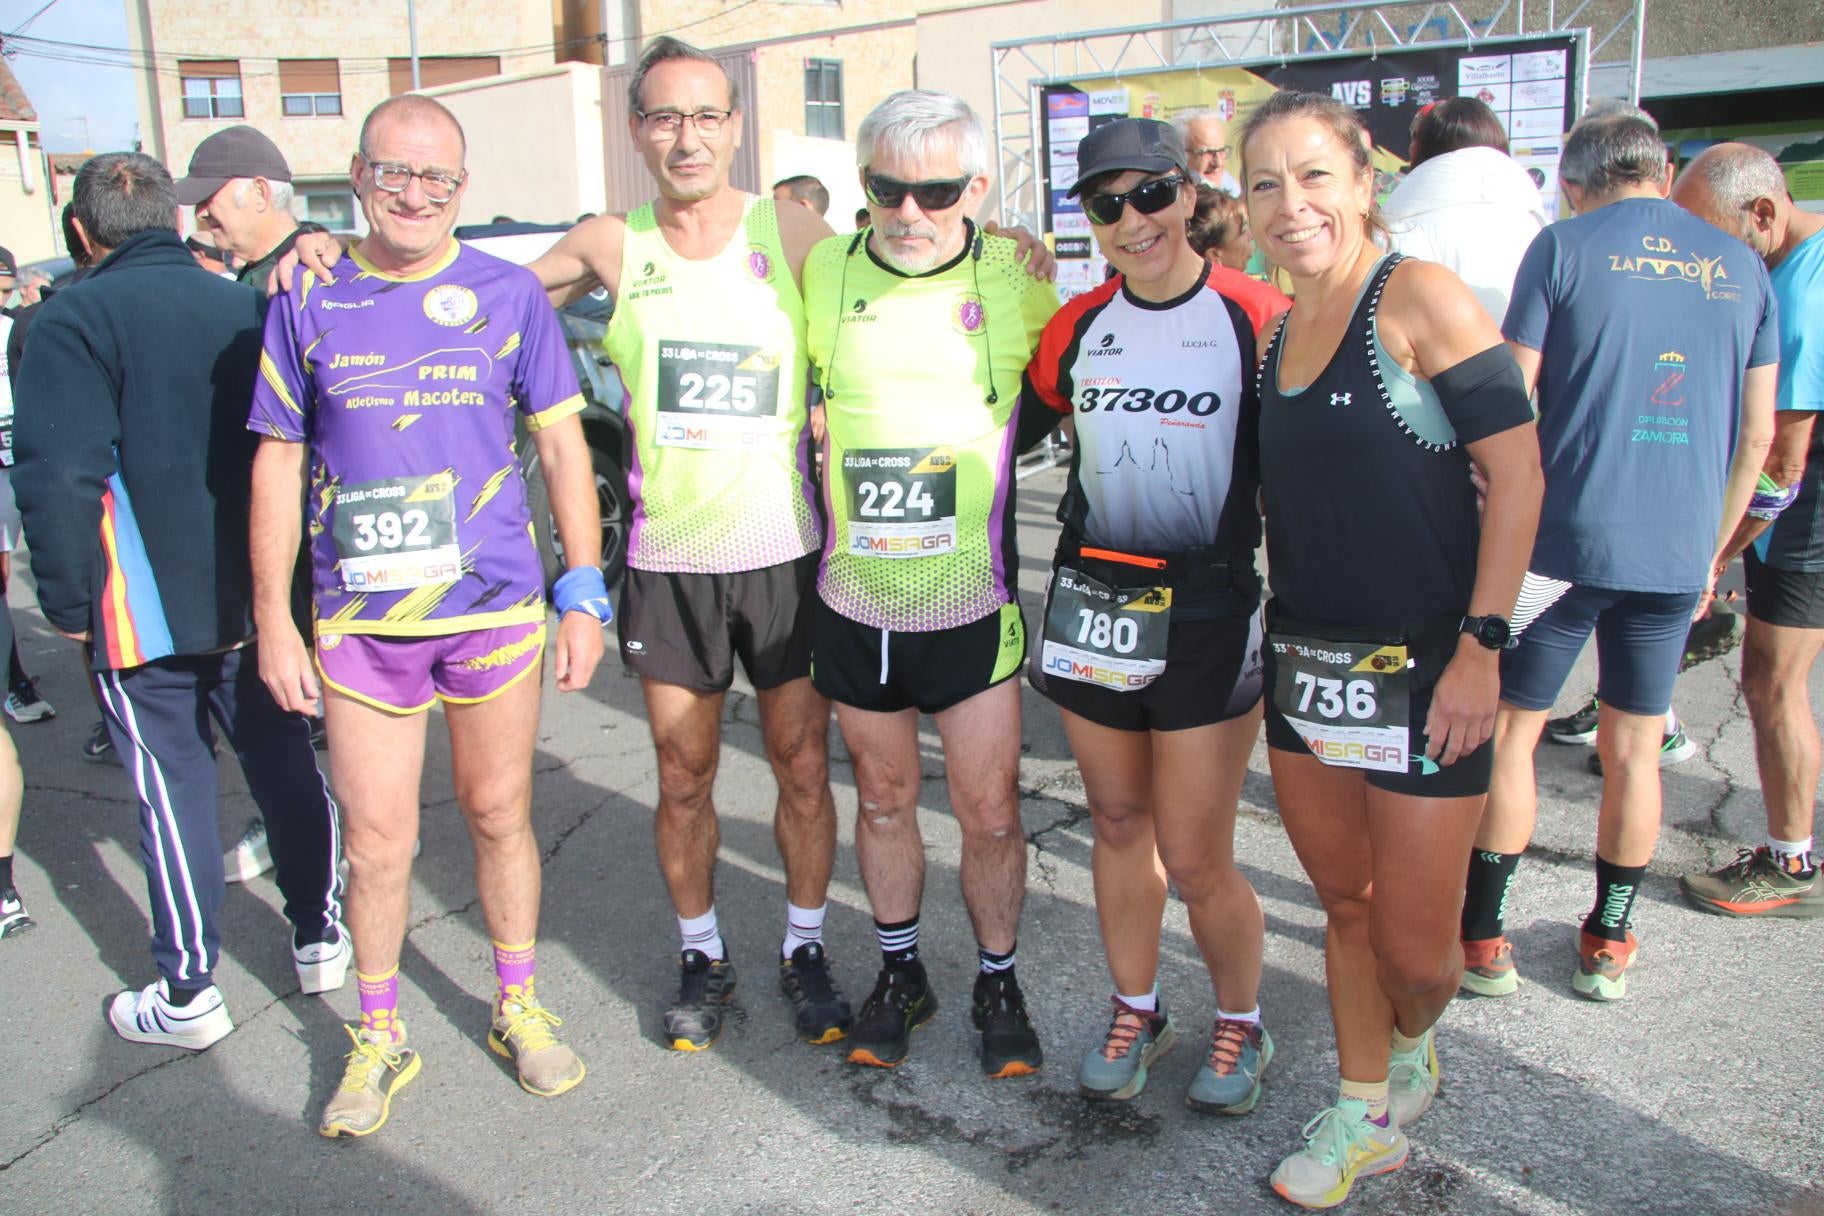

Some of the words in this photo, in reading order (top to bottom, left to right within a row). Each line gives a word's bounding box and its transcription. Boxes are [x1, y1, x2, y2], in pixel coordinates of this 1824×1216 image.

[1332, 80, 1372, 105] AVS
[1642, 236, 1678, 254] C.D.
[322, 299, 374, 310] MAGLIA
[842, 315, 876, 323] VIATOR
[329, 352, 386, 370] Jamón
[662, 348, 674, 358] 33
[674, 348, 698, 360] LA
[706, 350, 738, 362] CROSS
[1088, 348, 1122, 356] VIATOR
[1366, 329, 1380, 376] UNDER
[418, 365, 477, 381] PRIM
[346, 396, 394, 409] Atletismo
[404, 388, 484, 406] Macotera
[679, 372, 757, 412] 225
[1080, 388, 1222, 416] 37300
[1160, 418, 1206, 429] Peñaranda
[1632, 429, 1688, 445] ZAMORA
[844, 457, 854, 466] 33
[854, 458, 872, 468] LIGA
[878, 456, 911, 468] CROSS
[336, 494, 346, 504] 33
[346, 490, 366, 503] LIGA
[372, 486, 406, 499] CROSS
[858, 481, 934, 516] 224
[352, 509, 432, 551] 392
[852, 534, 952, 552] JOMISAGA
[1060, 577, 1072, 588] 33
[1098, 591, 1128, 603] CRSS
[1077, 608, 1138, 654] 180
[1272, 643, 1286, 653] 33
[1317, 650, 1352, 664] CROSS
[1295, 671, 1376, 720] 736
